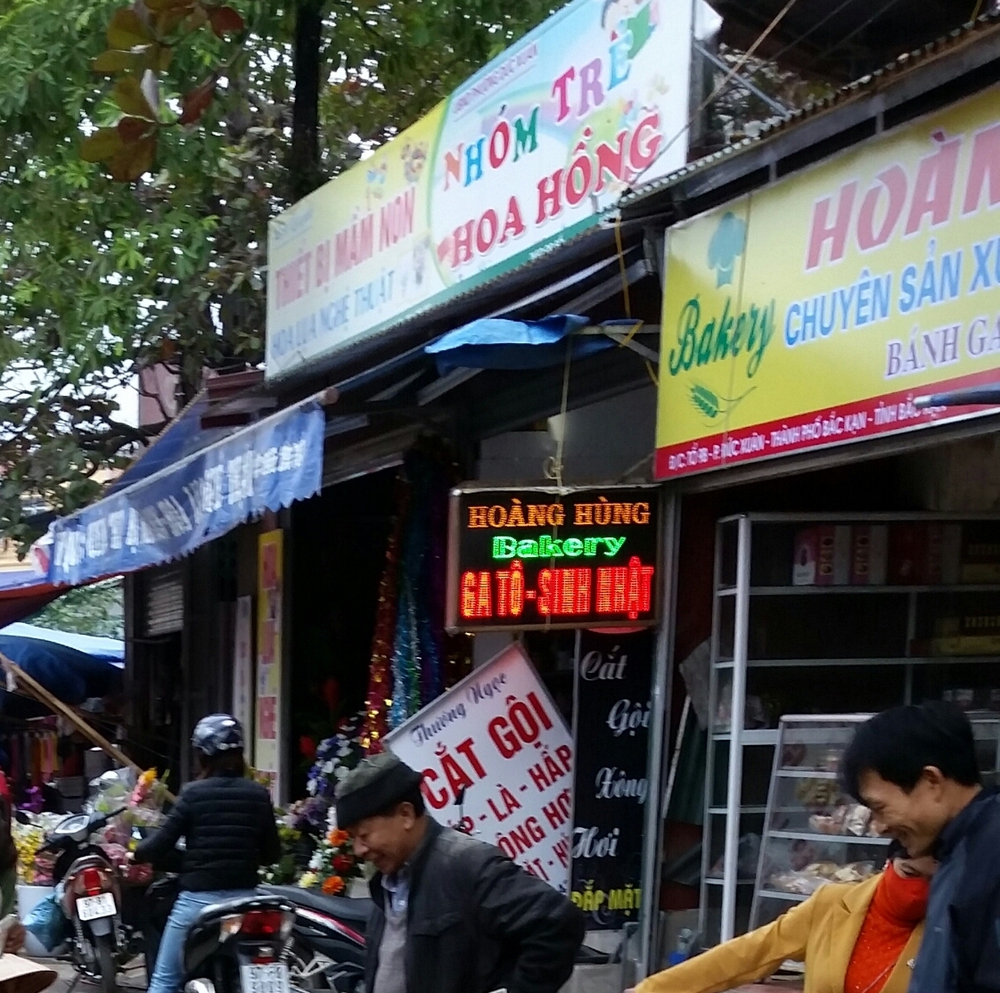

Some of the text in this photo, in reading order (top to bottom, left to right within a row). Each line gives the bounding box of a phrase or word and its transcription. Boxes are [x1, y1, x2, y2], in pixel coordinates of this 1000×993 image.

[443, 104, 540, 191] NHÓM
[451, 196, 526, 268] HOA
[785, 269, 892, 346] CHUYÊN
[899, 239, 962, 312] SẢN
[670, 293, 776, 378] Bakery
[886, 325, 961, 376] BÁNH
[468, 496, 650, 528] HOÀNG HÙNG
[492, 534, 627, 558] Bakery
[580, 645, 627, 681] Cắt
[606, 699, 651, 737] Gội
[419, 691, 553, 810] CẮT GỘI
[487, 783, 522, 822] LÀ
